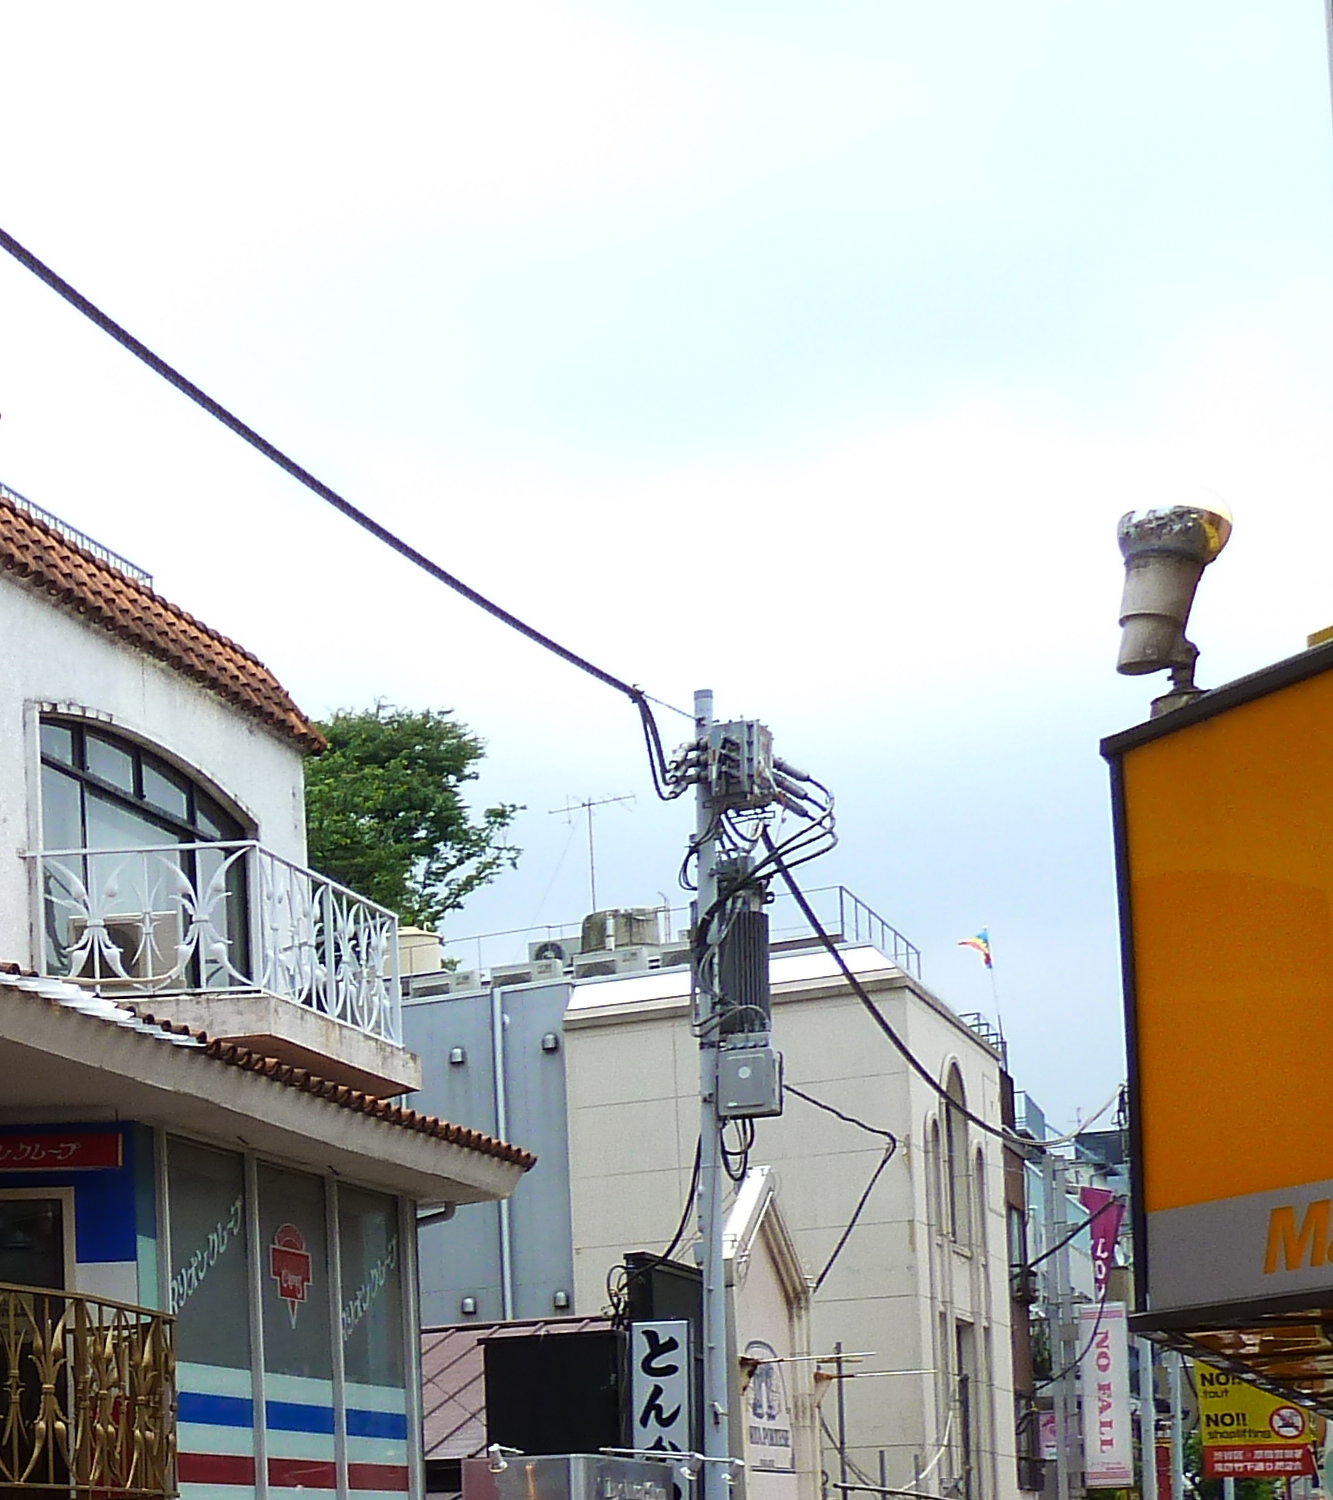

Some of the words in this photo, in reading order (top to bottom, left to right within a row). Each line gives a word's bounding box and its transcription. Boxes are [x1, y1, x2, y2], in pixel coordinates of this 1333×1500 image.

[1263, 1199, 1333, 1275] M
[1094, 1329, 1111, 1373] NO
[1203, 1388, 1229, 1399] tout
[1097, 1382, 1113, 1453] FALL
[1205, 1412, 1247, 1427] NO!!
[1208, 1428, 1272, 1440] shoplifting
